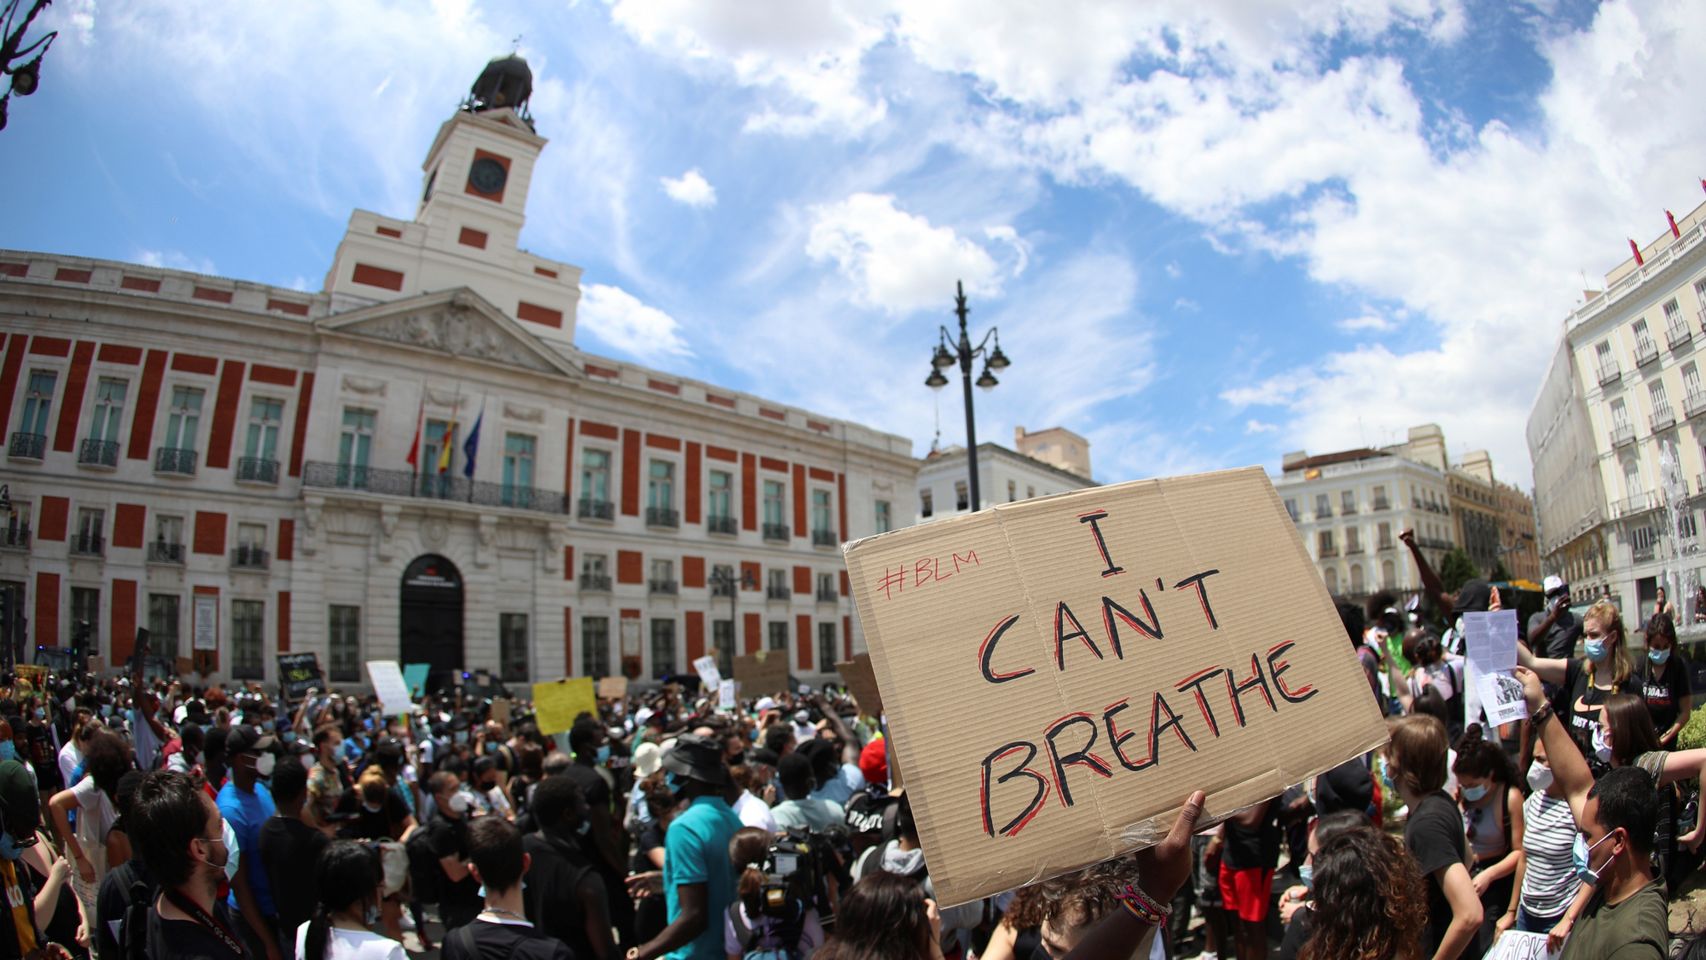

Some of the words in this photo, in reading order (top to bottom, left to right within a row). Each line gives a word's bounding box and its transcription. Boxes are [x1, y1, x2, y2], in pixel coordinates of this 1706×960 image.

[877, 550, 980, 601] #BLM
[1076, 509, 1127, 579] I
[978, 569, 1220, 684] CAN'T
[979, 640, 1320, 838] BREATHE
